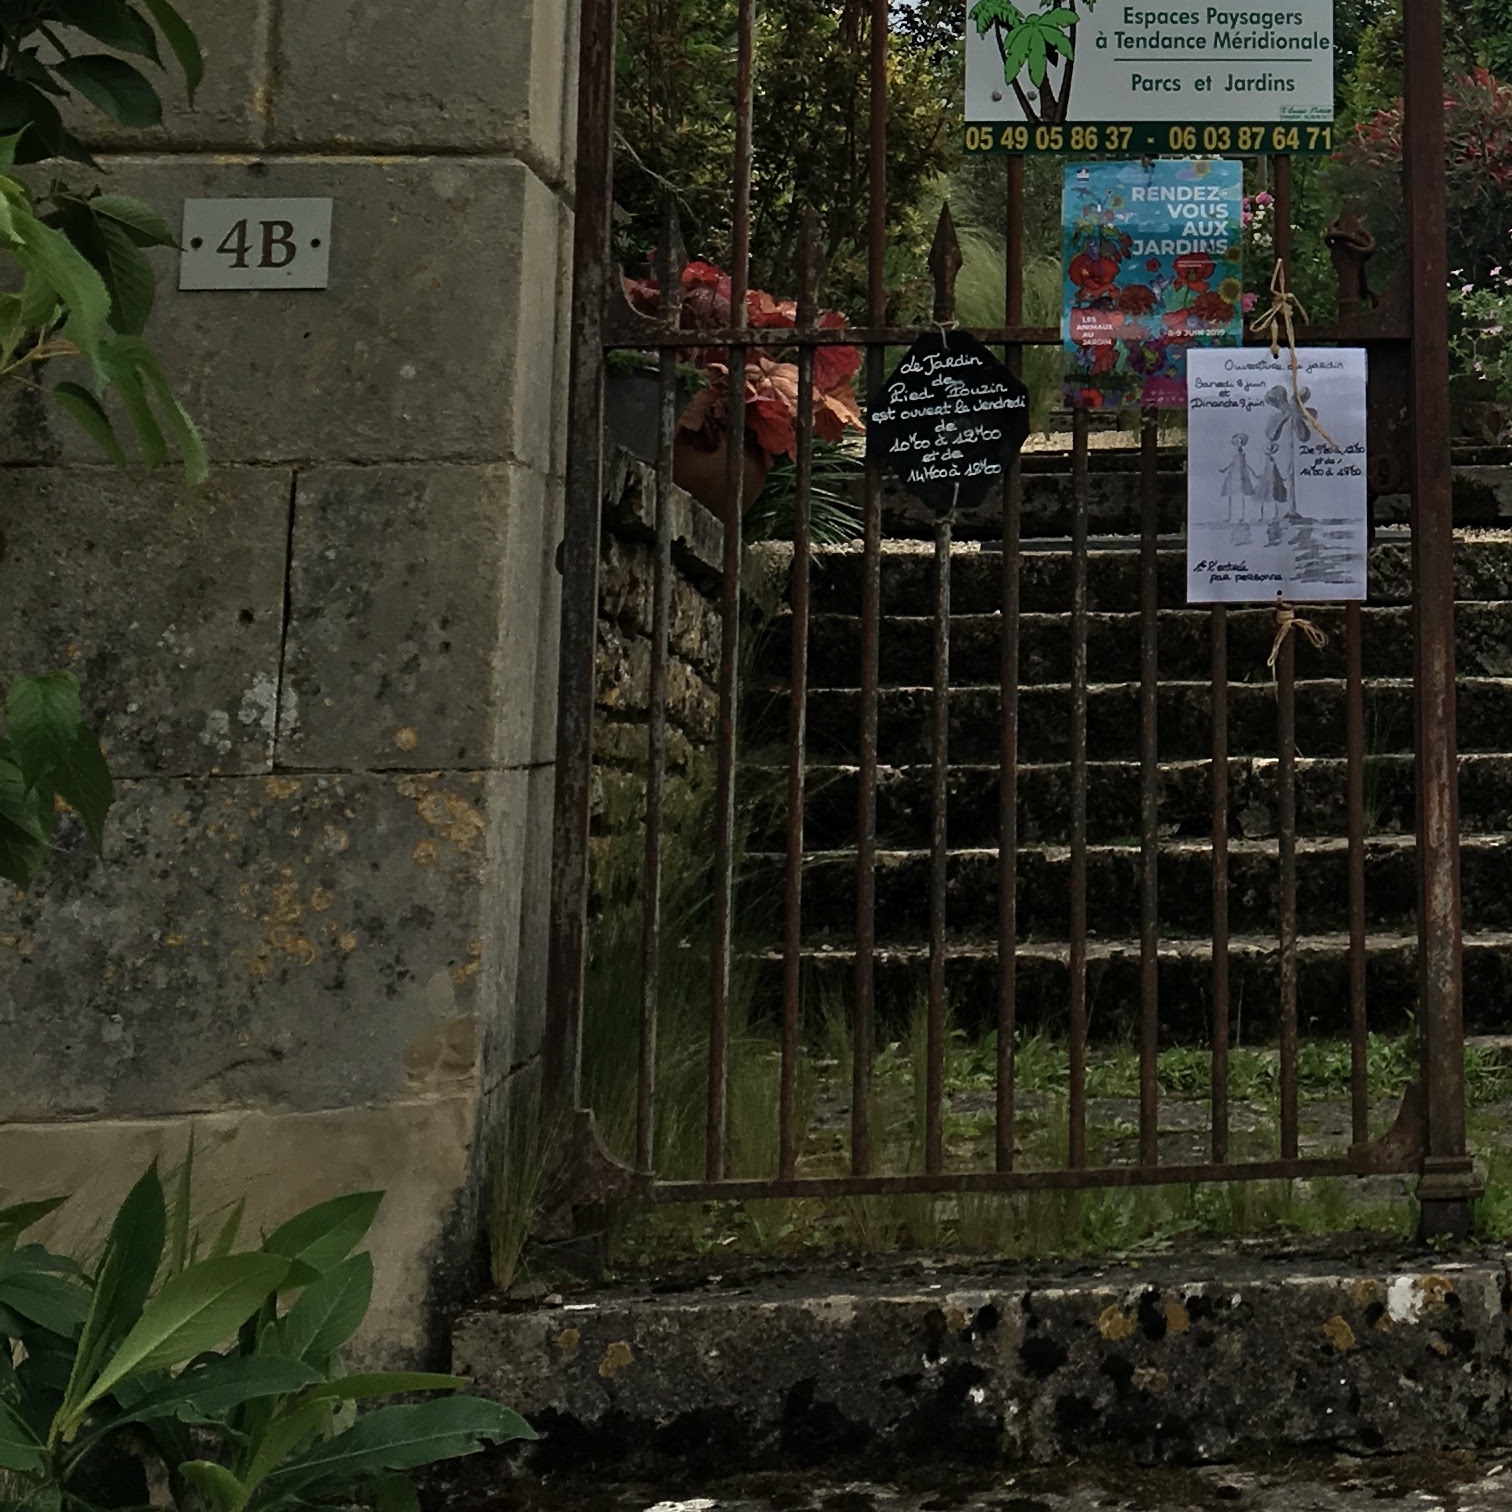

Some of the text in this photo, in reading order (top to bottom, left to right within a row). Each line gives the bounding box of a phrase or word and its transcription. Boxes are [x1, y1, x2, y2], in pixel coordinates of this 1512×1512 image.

[1123, 7, 1303, 30] Espaces Paysagers
[1096, 31, 1330, 49] à Tendance Méridionale
[1132, 73, 1295, 91] Parcs et Jardins
[965, 127, 993, 150] 05
[1001, 127, 1028, 150] 49
[1035, 127, 1062, 150] 05
[1070, 127, 1098, 150] 86
[1106, 127, 1133, 150] 37
[1169, 126, 1196, 150] 06
[1203, 127, 1231, 151] 03
[1238, 127, 1265, 150] 87
[1272, 127, 1299, 150] 64
[1306, 127, 1331, 150] 71
[1167, 203, 1228, 219] VOUS
[1182, 221, 1228, 236] AUX
[216, 219, 296, 268] 4B
[1132, 239, 1227, 255] JARDINS
[923, 353, 983, 375] Jardin
[931, 373, 953, 387] de
[888, 380, 1008, 404] Pied Pouzin
[872, 395, 1025, 424] est ouvert le vendredi
[935, 419, 957, 433] de
[935, 434, 948, 446] à
[922, 448, 964, 463] et de
[949, 464, 960, 476] à
